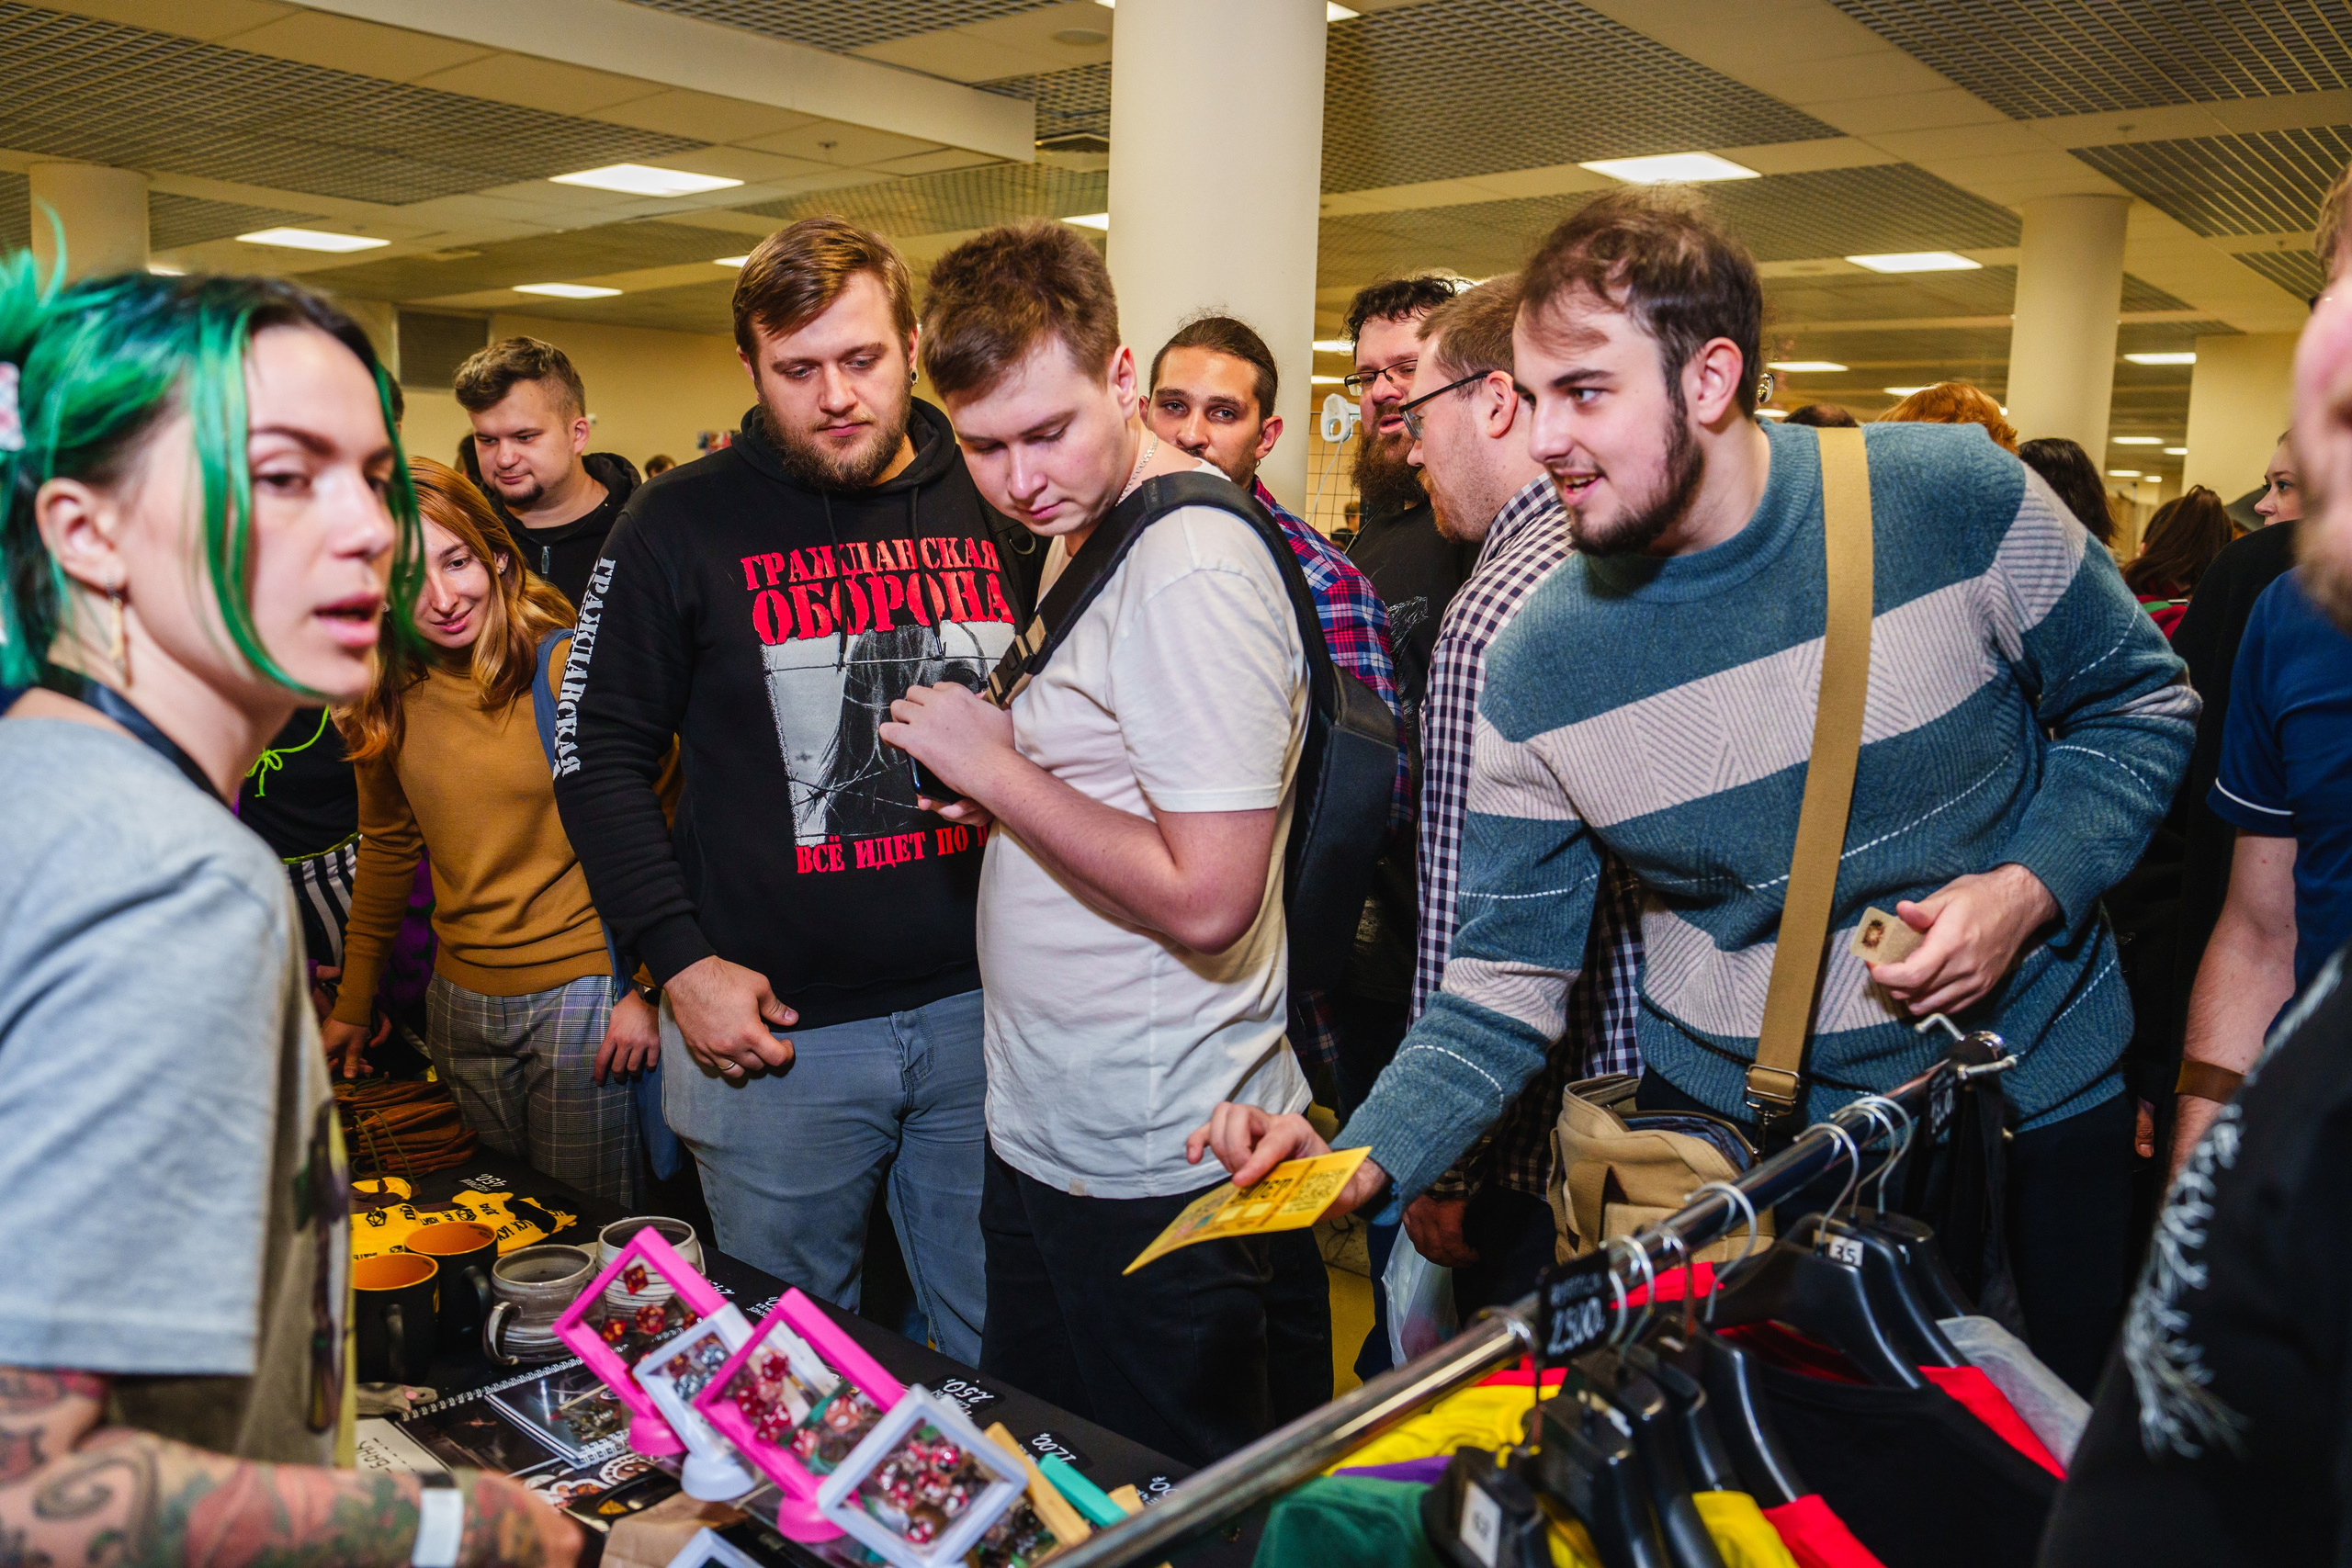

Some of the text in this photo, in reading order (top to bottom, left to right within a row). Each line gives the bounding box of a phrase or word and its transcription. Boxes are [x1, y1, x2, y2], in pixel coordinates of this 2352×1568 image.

[741, 536, 1001, 591] ГРАЖДАНСКАЯ
[752, 570, 1015, 645] ОБОРОНА
[556, 557, 616, 778] ГРАЖДАНСКАЯ
[796, 835, 845, 874] ВСЁ
[854, 831, 926, 871] ИДЕТ
[935, 825, 968, 856] ПО
